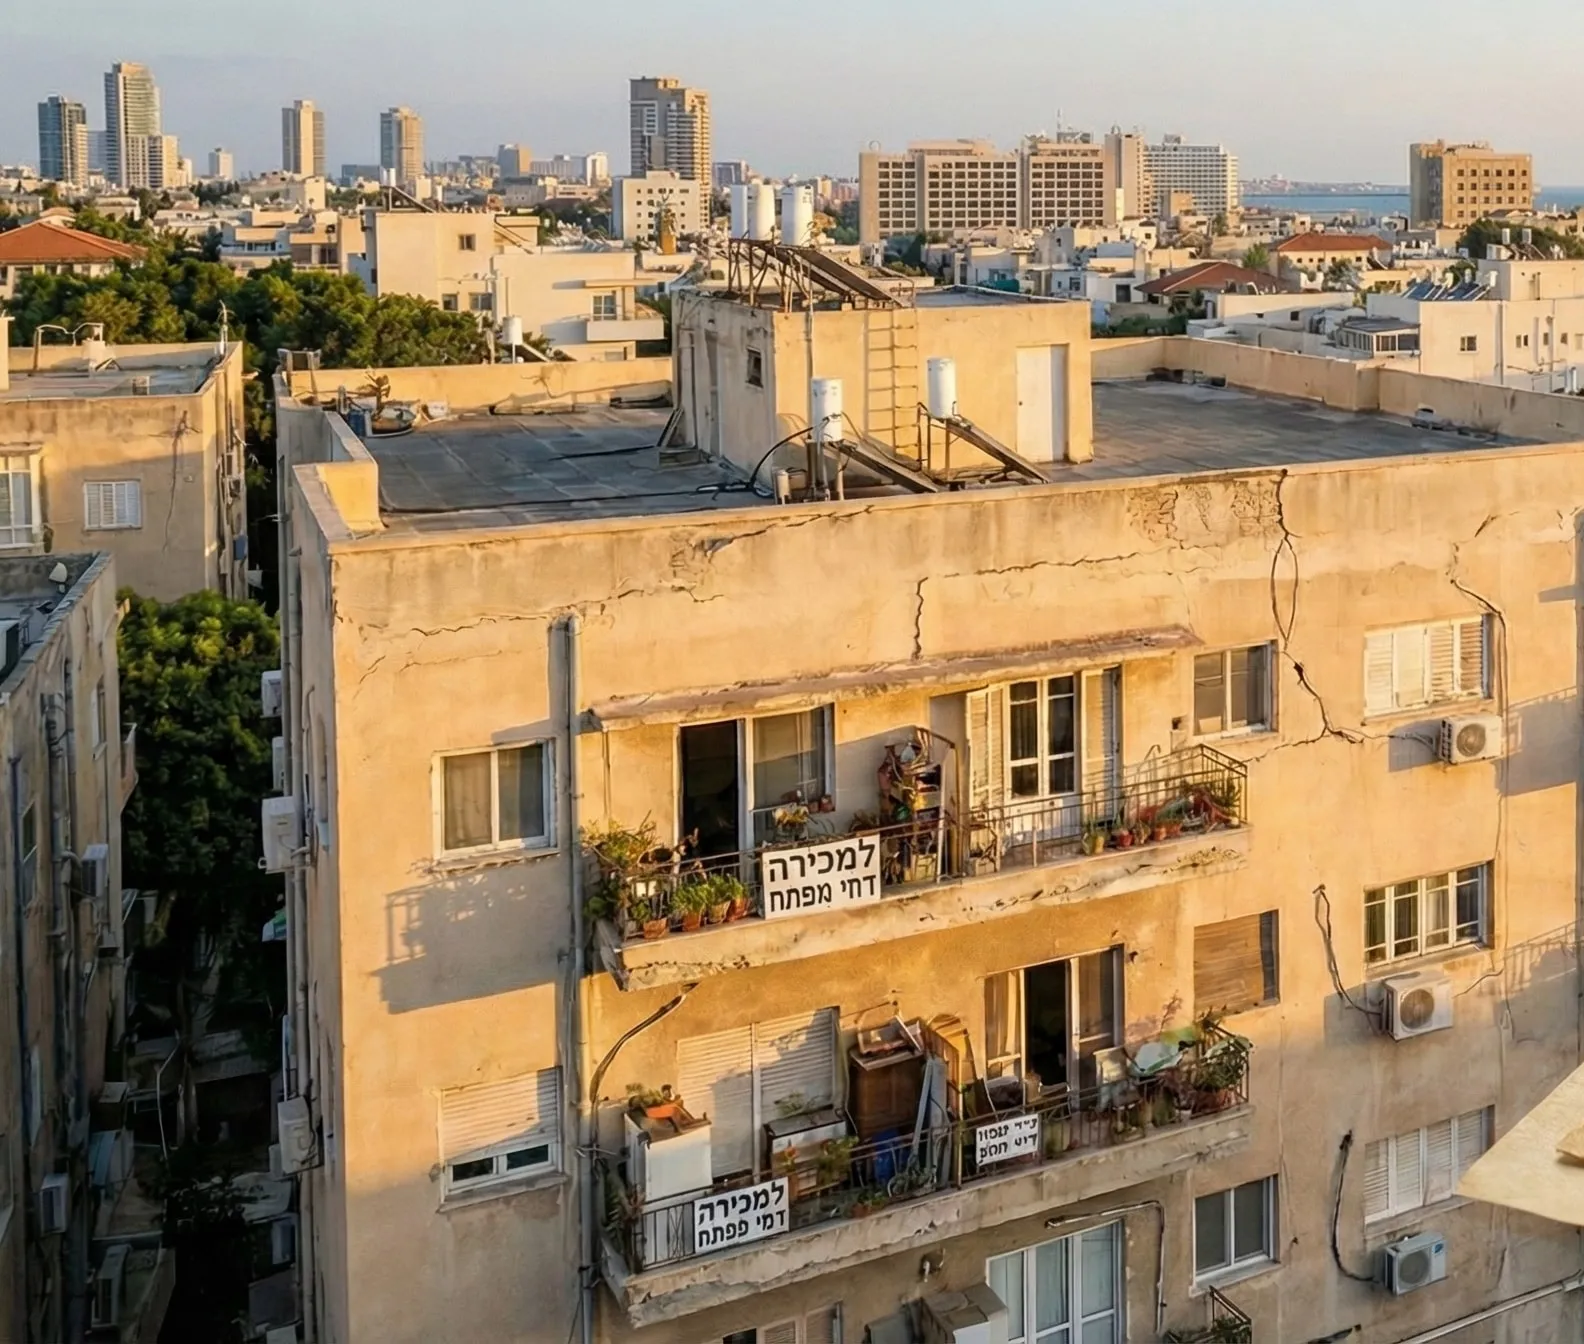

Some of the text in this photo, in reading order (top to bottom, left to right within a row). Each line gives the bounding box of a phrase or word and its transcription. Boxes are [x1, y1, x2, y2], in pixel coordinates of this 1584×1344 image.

[769, 839, 875, 882] למכירה
[770, 882, 832, 912] מפתח
[699, 1182, 784, 1225] למכירה
[756, 1210, 786, 1231] דמי
